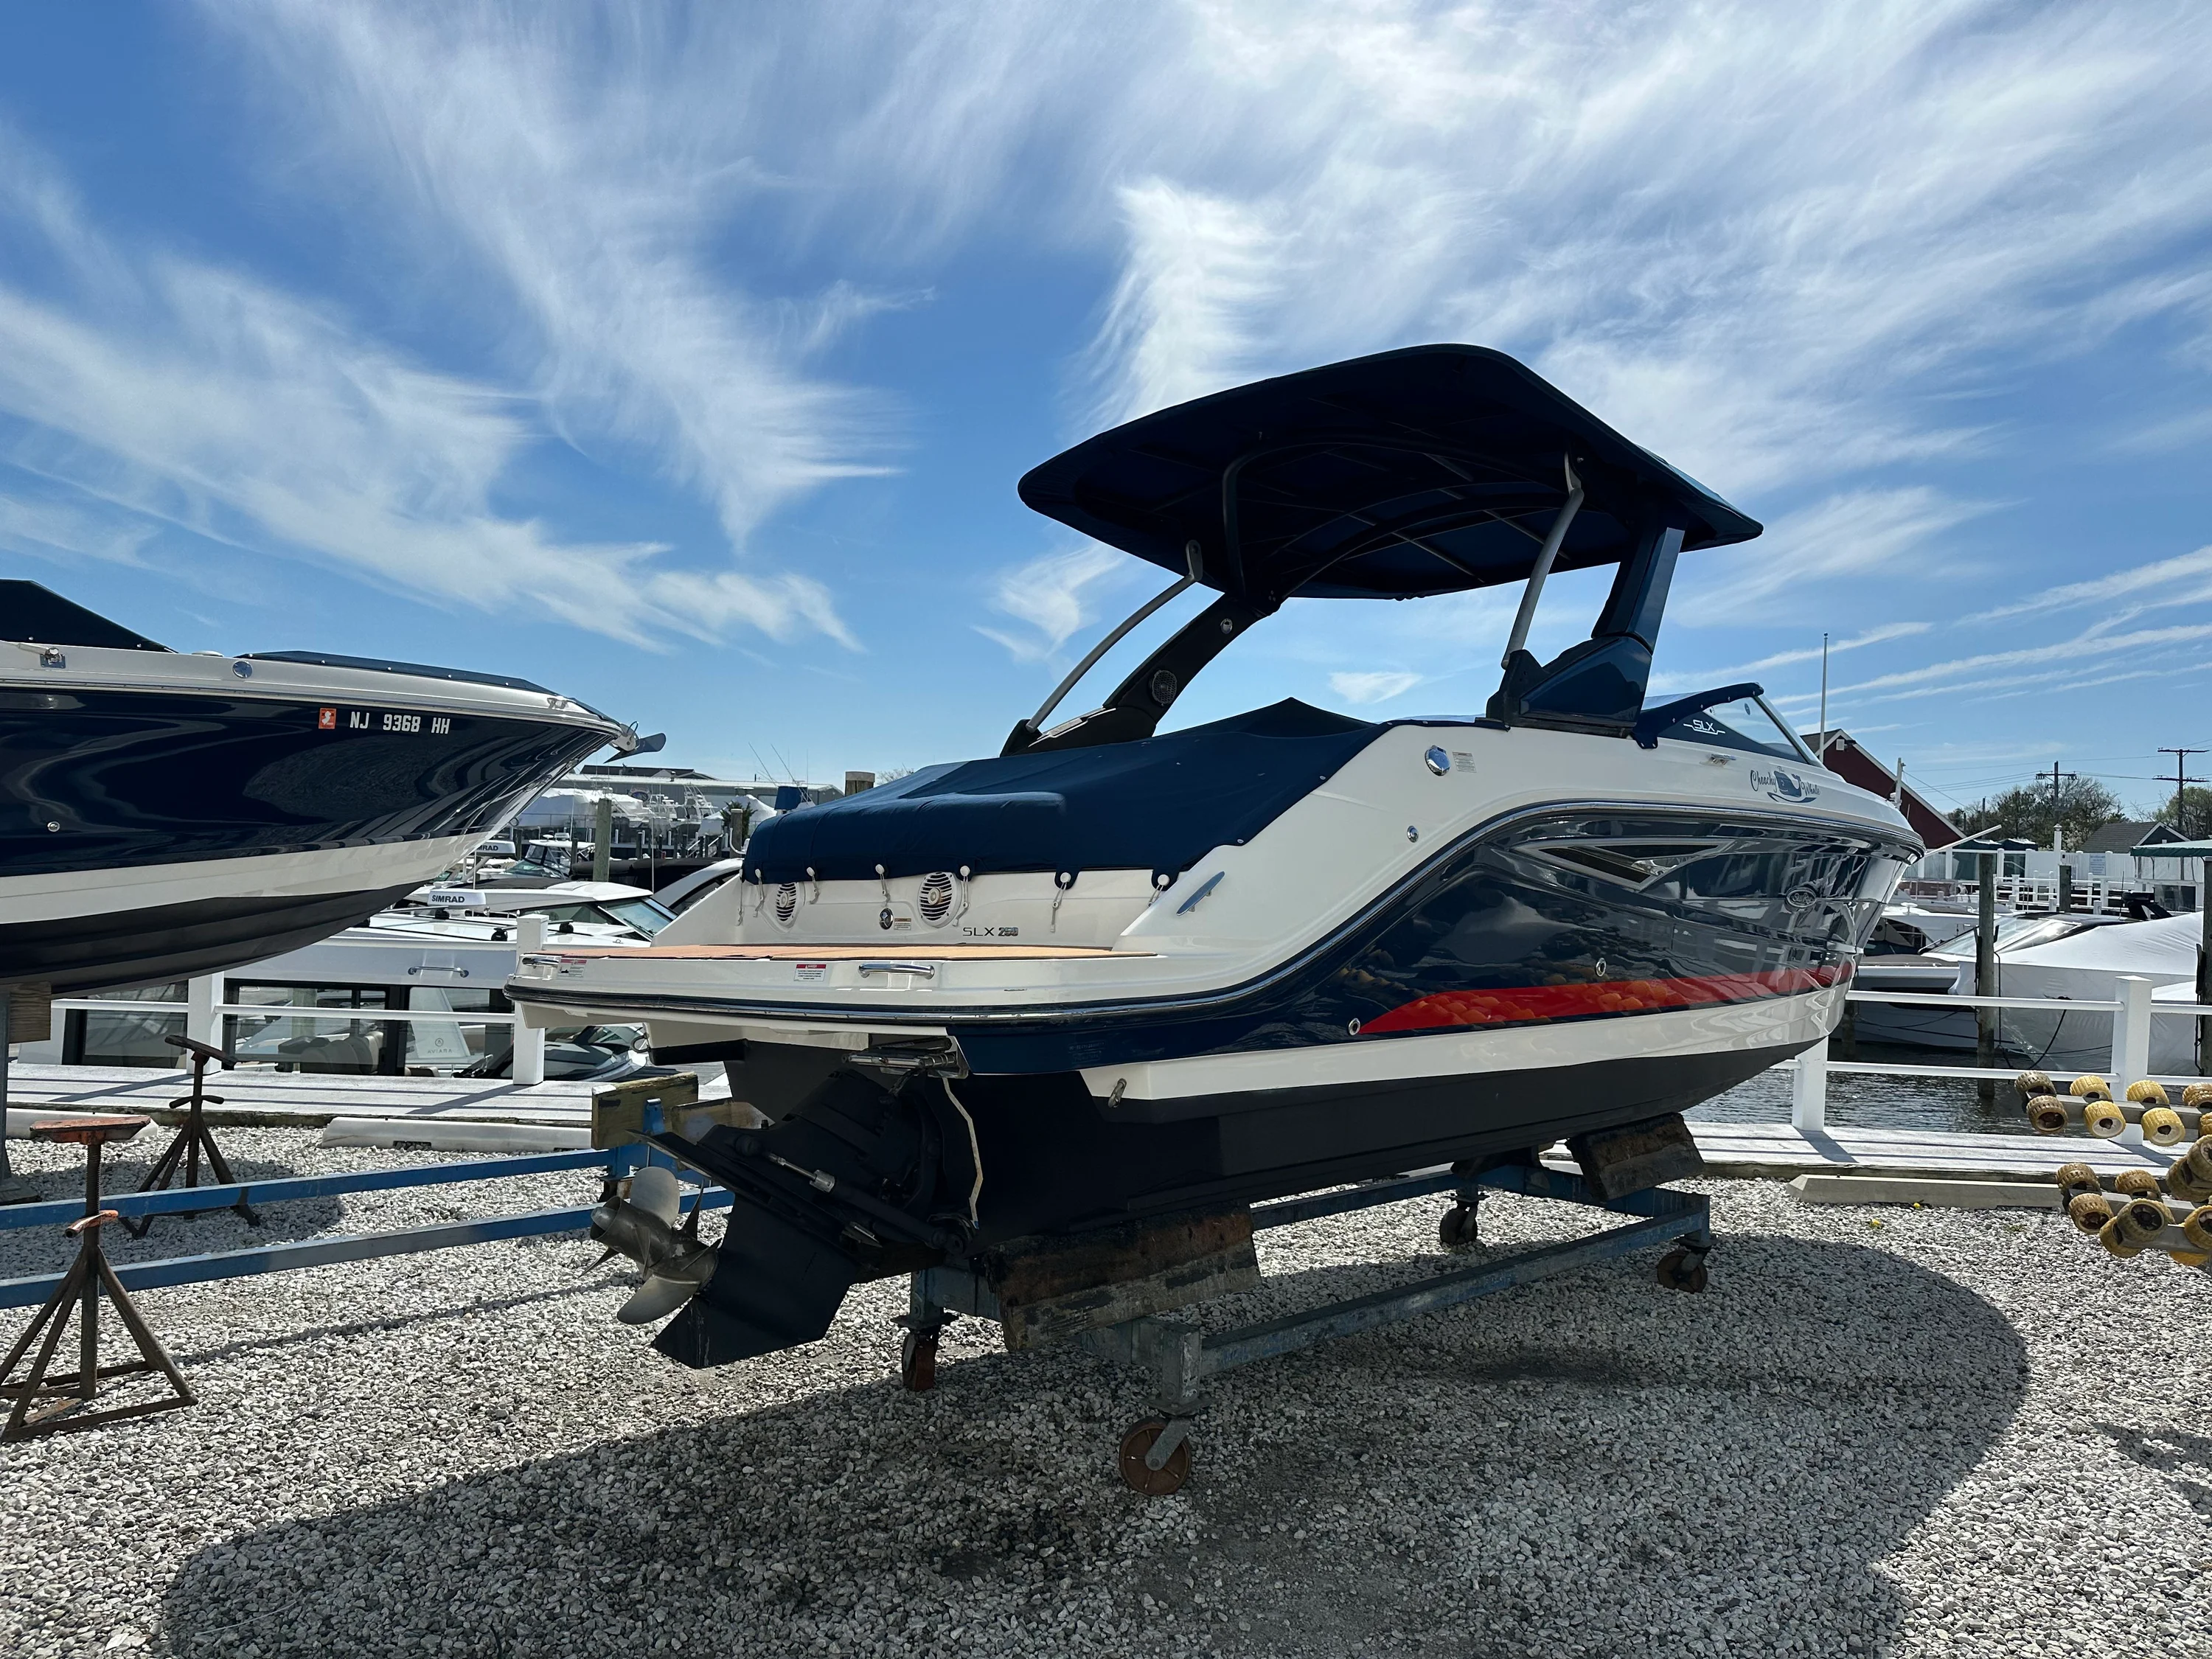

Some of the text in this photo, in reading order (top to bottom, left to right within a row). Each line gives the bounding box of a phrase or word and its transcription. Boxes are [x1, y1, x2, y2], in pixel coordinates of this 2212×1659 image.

[349, 712, 369, 729] NJ
[383, 714, 421, 732] 9368
[431, 717, 451, 734] HH
[1693, 719, 1716, 732] SLX
[431, 894, 465, 903] SIMRAD
[962, 927, 995, 936] SLX
